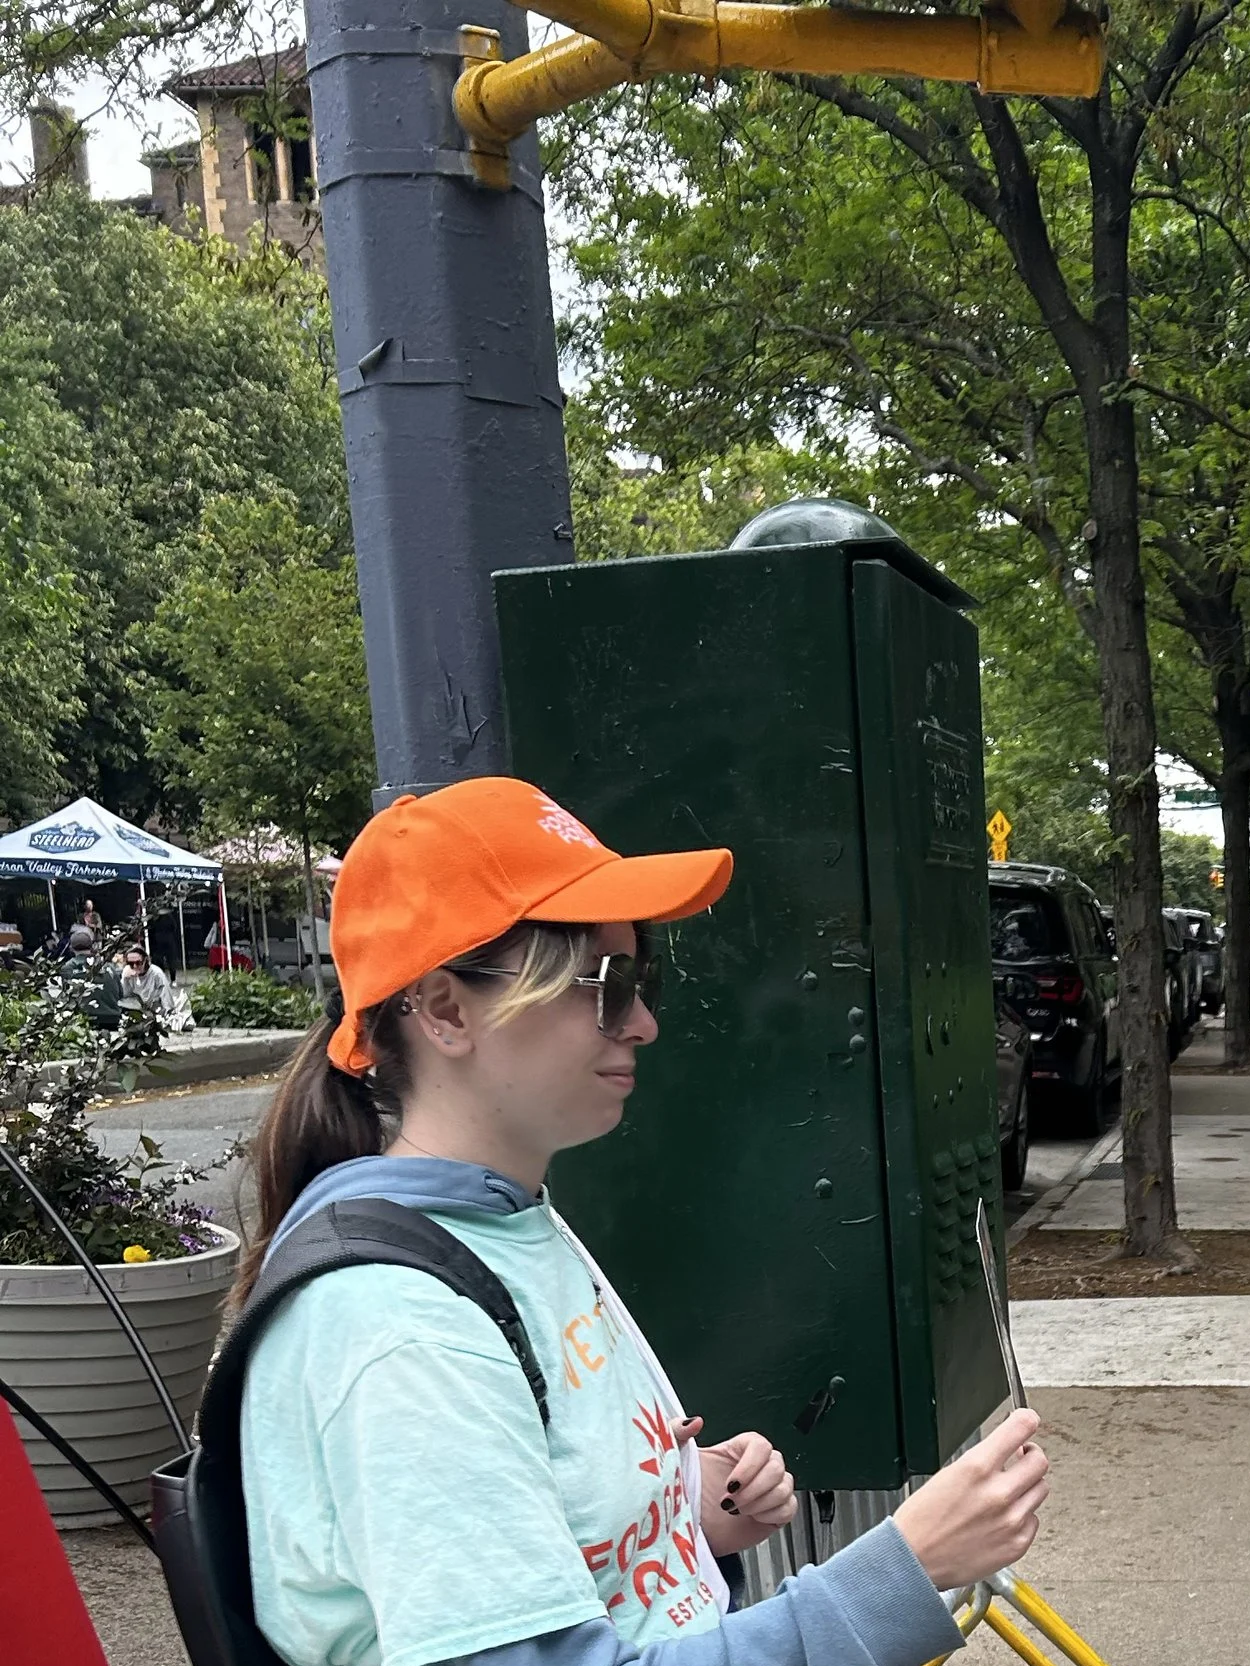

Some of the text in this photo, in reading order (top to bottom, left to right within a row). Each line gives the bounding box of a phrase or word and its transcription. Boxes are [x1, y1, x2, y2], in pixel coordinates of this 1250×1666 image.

[31, 834, 96, 848] STEELHEAD
[0, 860, 119, 877] dson Valley Fisheries
